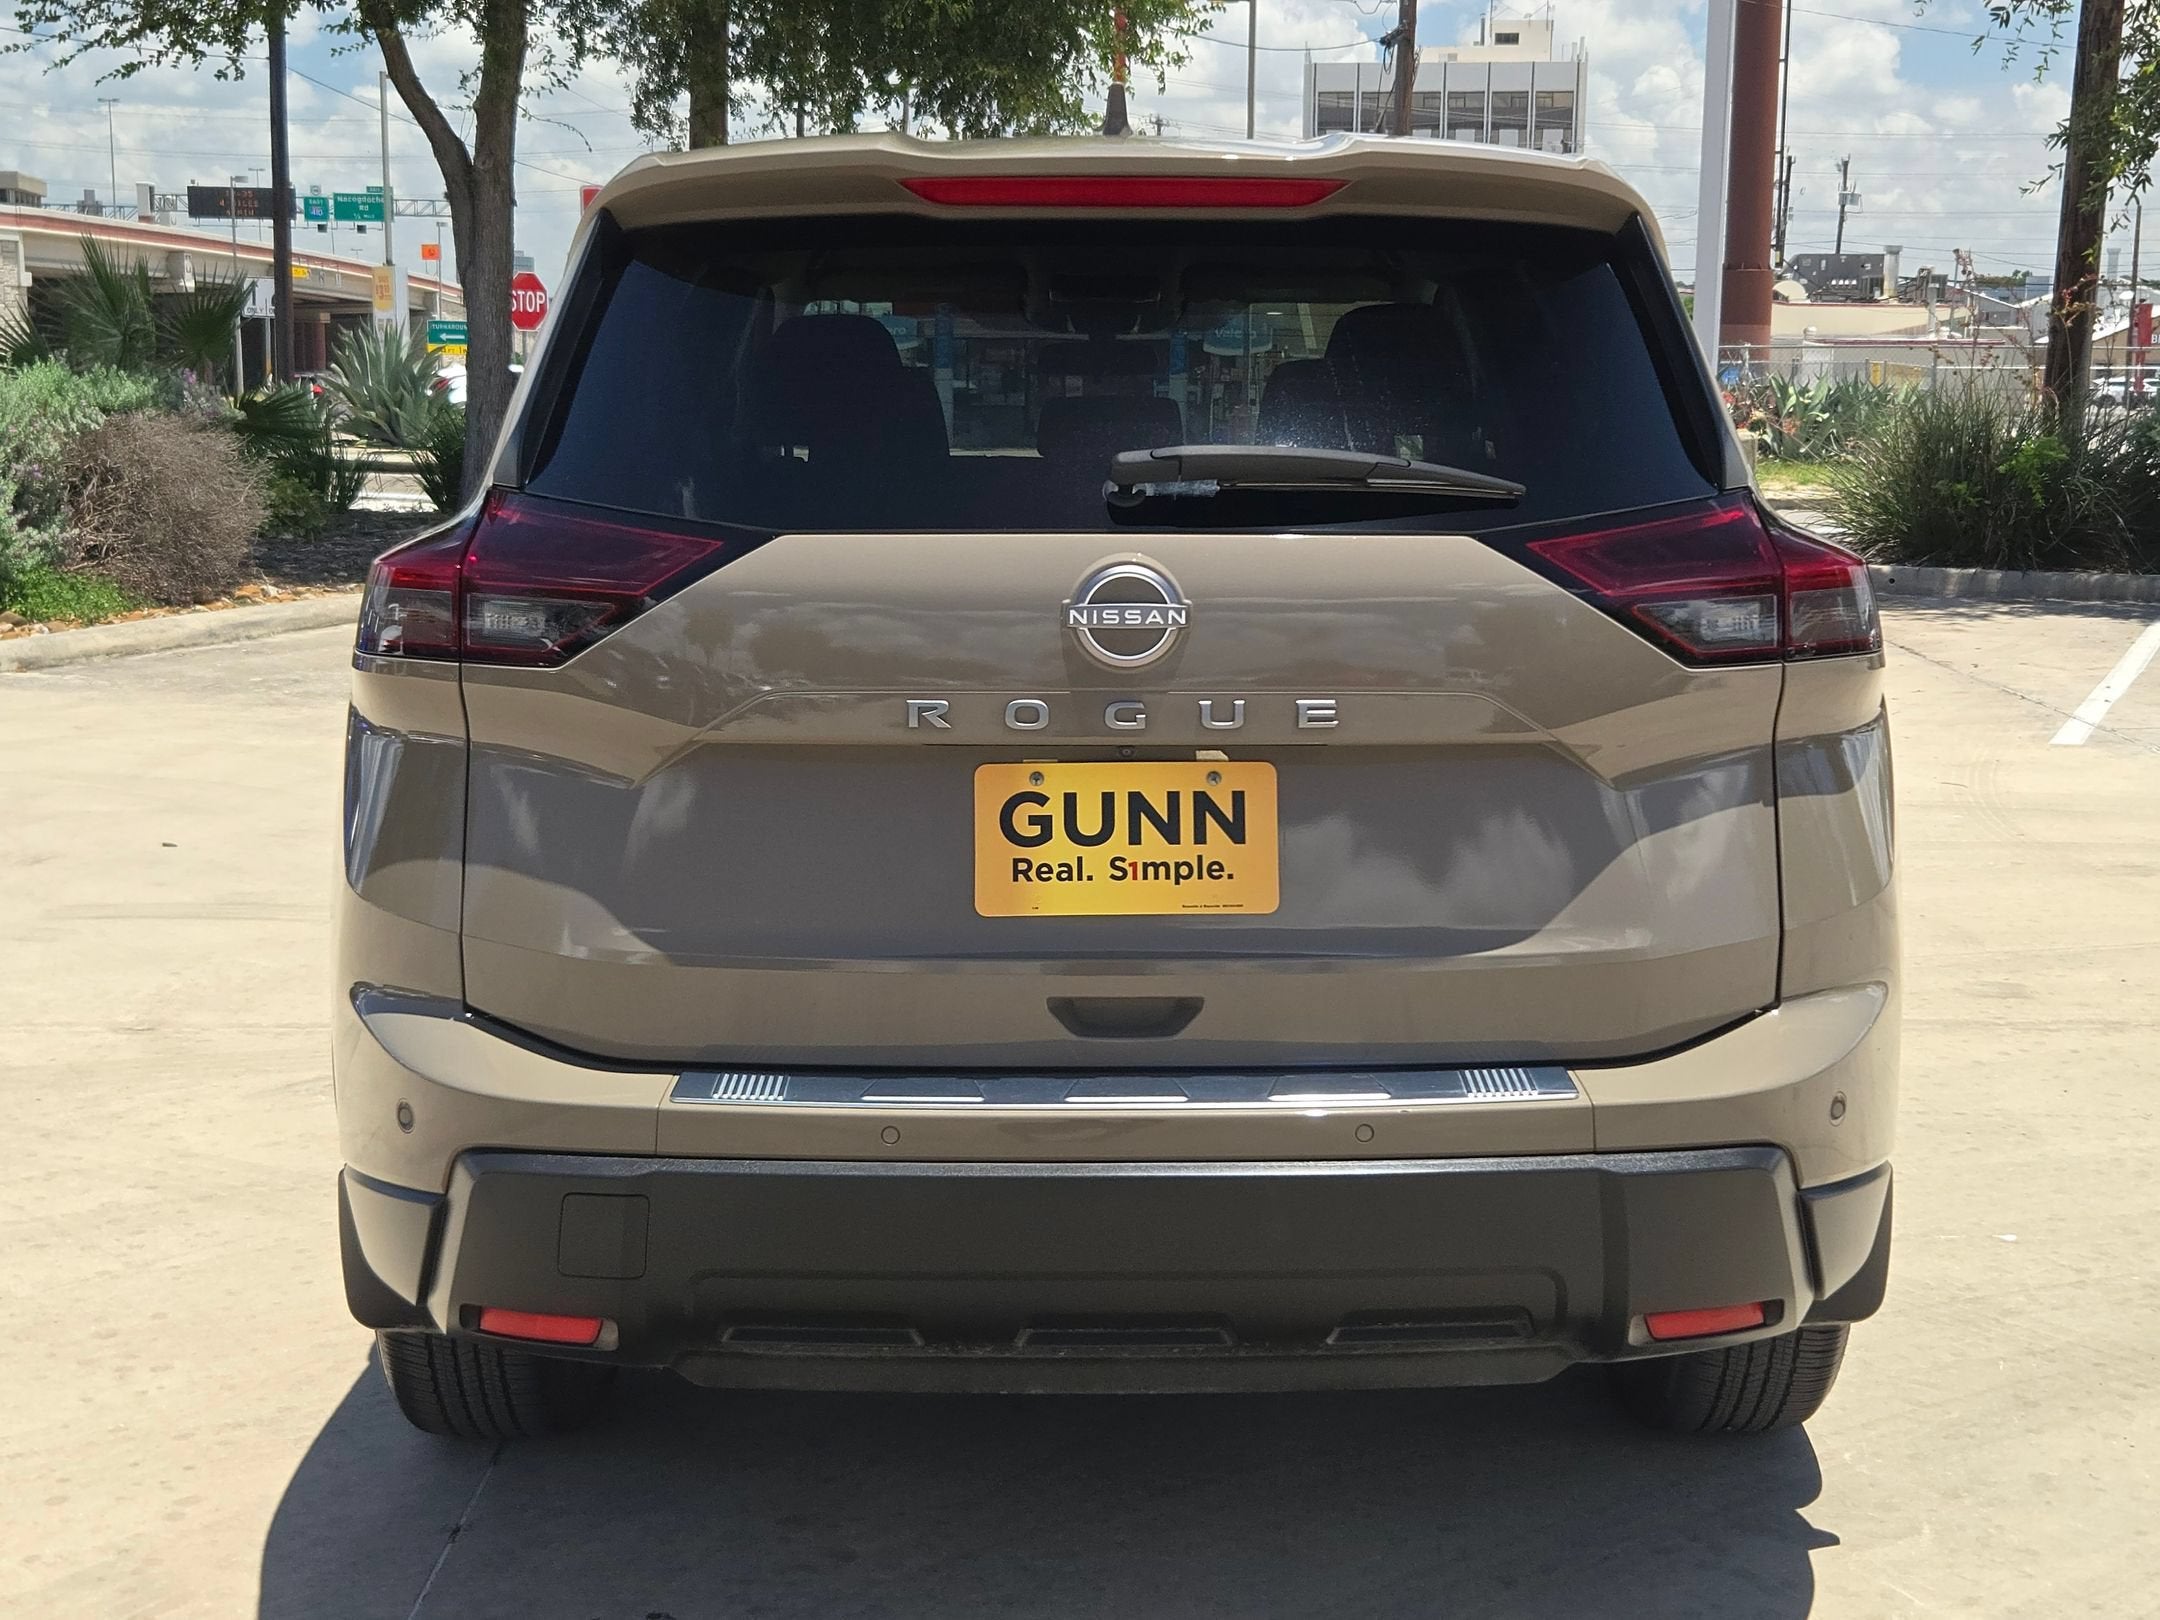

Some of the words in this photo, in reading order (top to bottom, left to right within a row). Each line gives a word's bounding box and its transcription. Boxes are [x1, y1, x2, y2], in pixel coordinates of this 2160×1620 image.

[511, 290, 546, 312] STOP
[1068, 608, 1188, 626] NISSAN
[905, 698, 1340, 730] ROGUE
[998, 790, 1247, 848] GUNN
[1011, 855, 1094, 883] Real.
